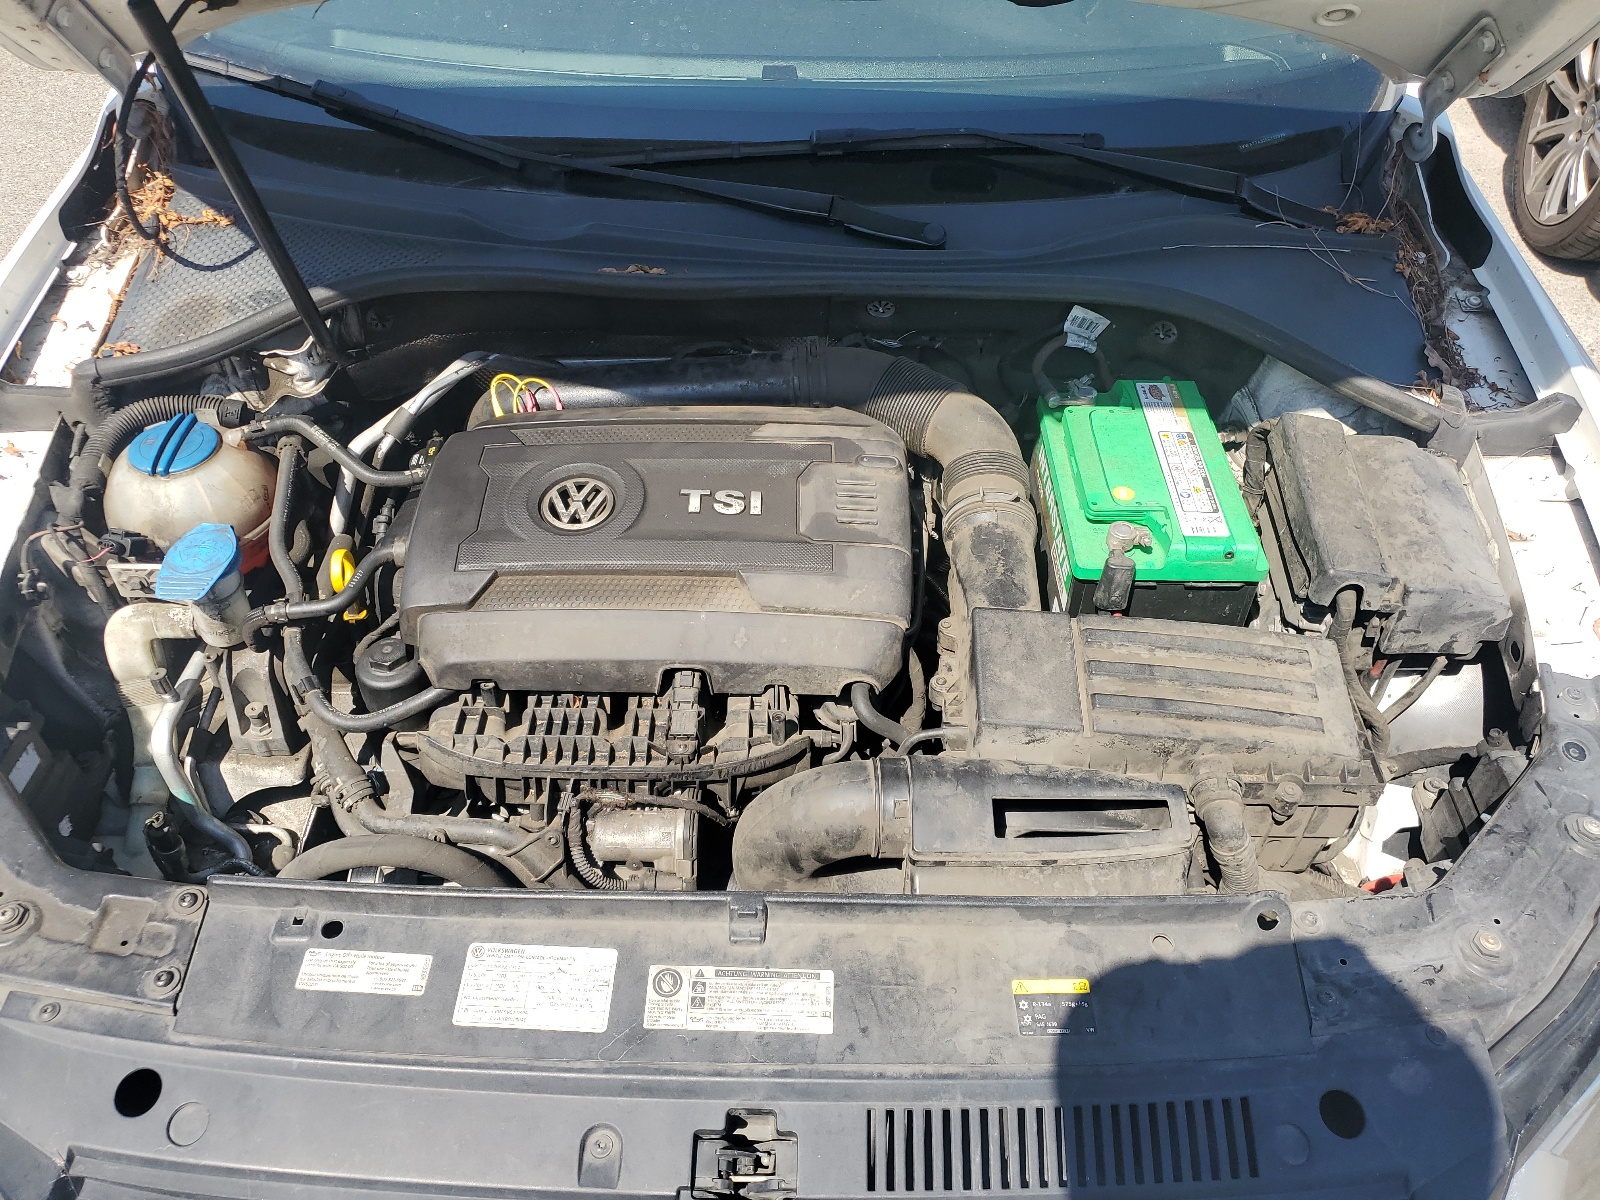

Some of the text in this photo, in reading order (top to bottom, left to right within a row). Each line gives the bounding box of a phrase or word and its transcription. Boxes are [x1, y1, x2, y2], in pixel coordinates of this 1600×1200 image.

[680, 489, 762, 515] TSI
[717, 970, 748, 978] ACHTUNG
[750, 971, 780, 979] WARNING
